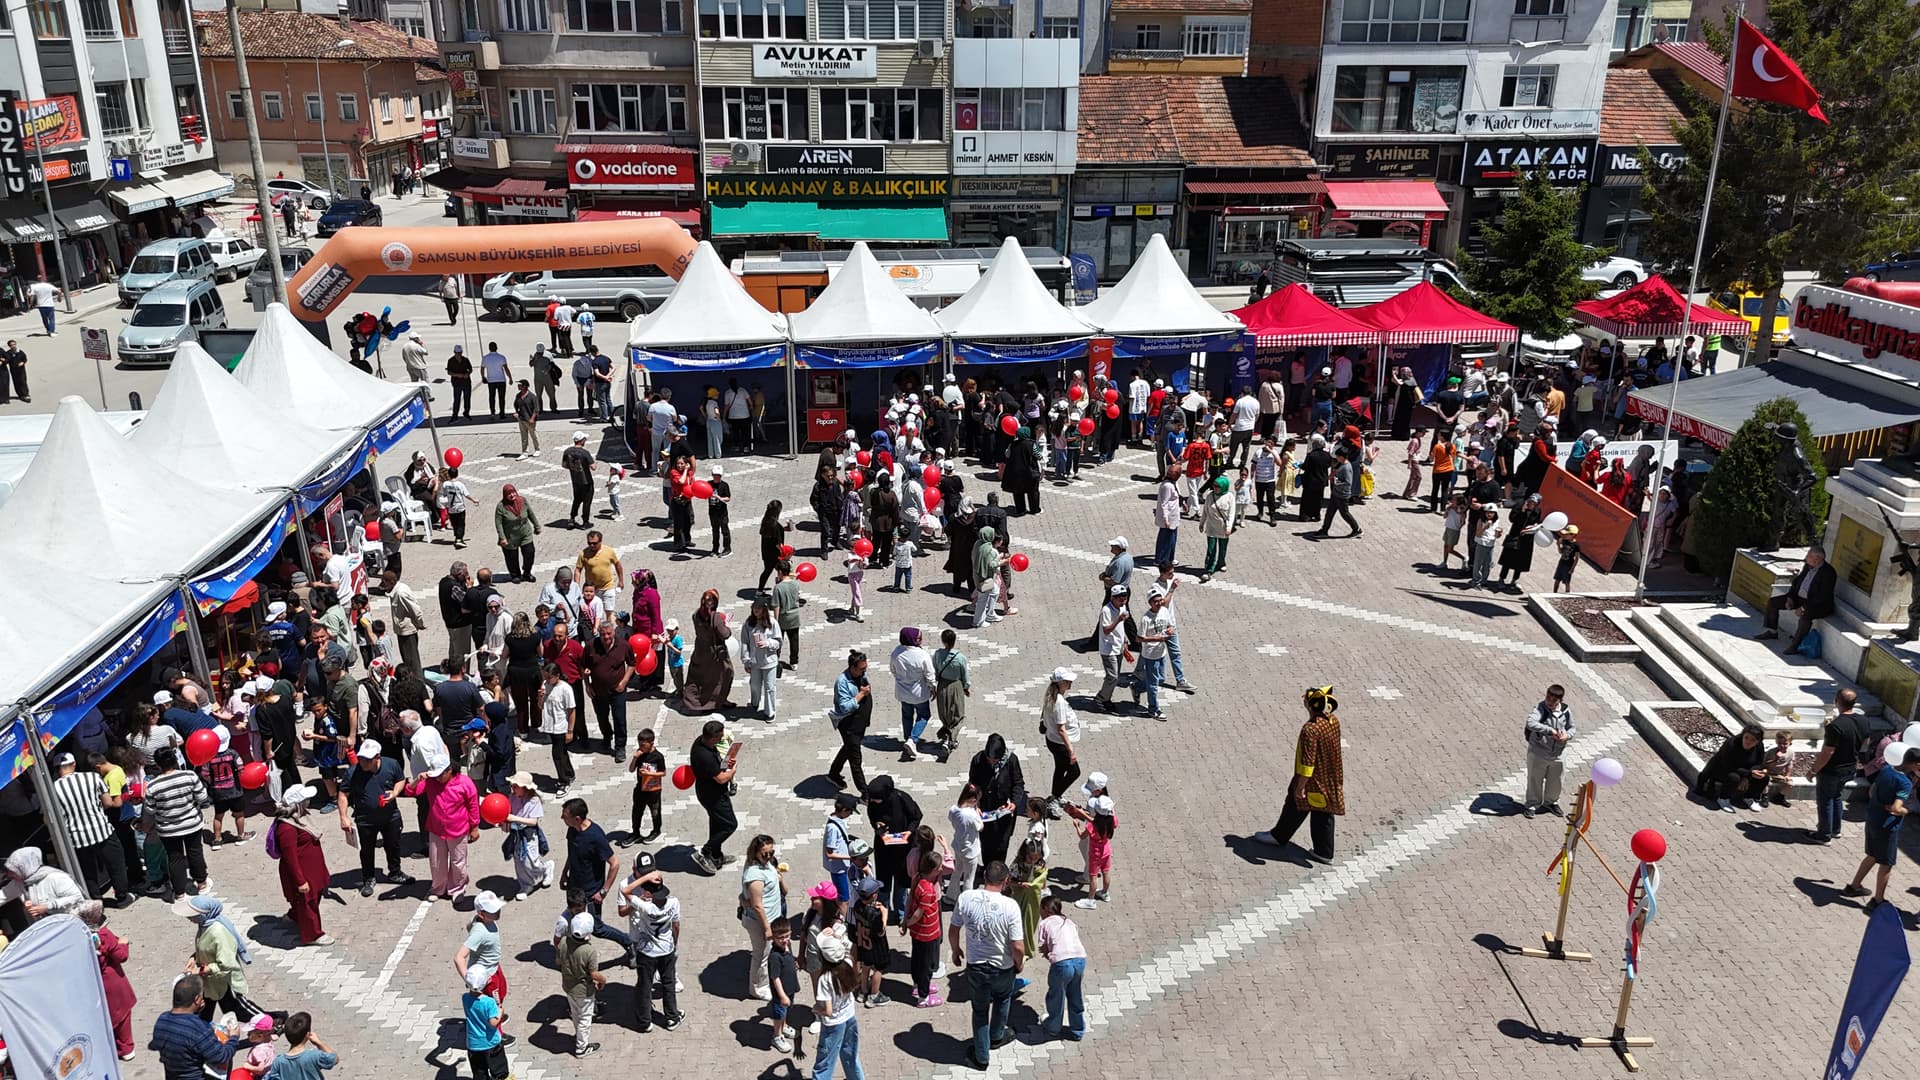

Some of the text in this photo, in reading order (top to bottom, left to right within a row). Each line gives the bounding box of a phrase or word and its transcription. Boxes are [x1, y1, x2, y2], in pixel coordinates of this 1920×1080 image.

[763, 47, 867, 61] AVUKAT
[780, 61, 851, 70] Metin YILDIRIM
[1482, 114, 1521, 132] Kader
[1522, 112, 1553, 130] Öner
[799, 149, 853, 165] AREN
[956, 151, 1054, 163] mimar AHMET KESKİN
[1365, 146, 1430, 163] ŞAHİNLER
[1474, 146, 1587, 166] ATAKAN
[601, 161, 677, 176] vodafone
[1524, 166, 1588, 180] KAFÖR
[706, 179, 947, 199] HALK MANAV & BALIKÇILIK
[504, 196, 564, 208] ECZANE
[417, 240, 641, 264] SAMSUN BÜYÜKŞEHİR BELEDİYESİ
[302, 268, 343, 307] GURURLA
[316, 276, 352, 311] SAMSUN
[1255, 354, 1285, 365] arlıyor
[815, 418, 838, 427] Popcorn
[211, 762, 234, 781] 10
